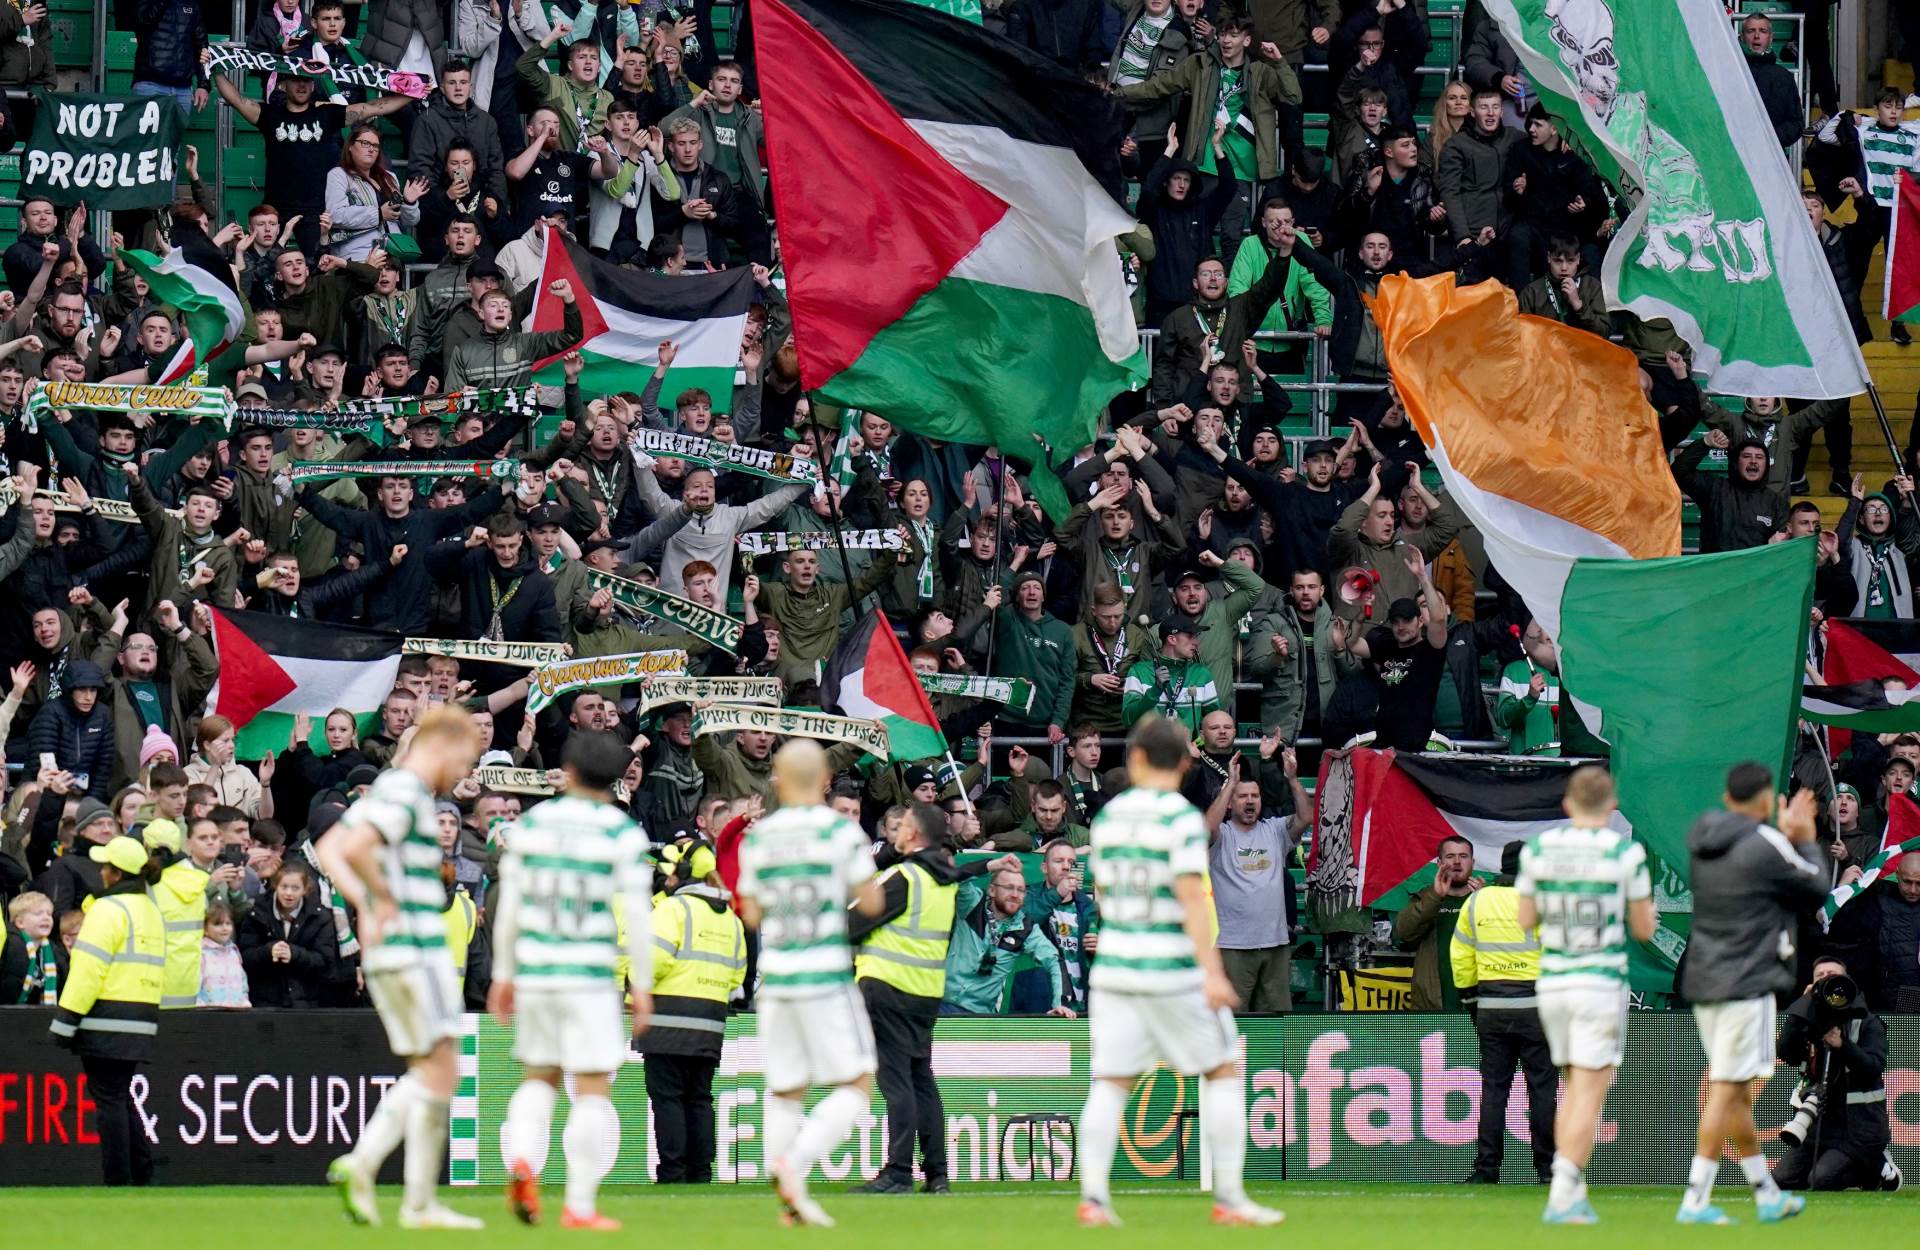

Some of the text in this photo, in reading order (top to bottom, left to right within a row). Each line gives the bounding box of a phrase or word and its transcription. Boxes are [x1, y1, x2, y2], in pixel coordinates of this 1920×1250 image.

[56, 101, 160, 137] NOT A
[45, 382, 202, 409] Ultras Celtic
[636, 428, 809, 479] NORTH CURVE
[662, 597, 741, 647] CURVE
[406, 639, 433, 651] OF
[462, 641, 500, 656] THE
[537, 656, 630, 697] Champions
[675, 682, 693, 695] OF
[712, 681, 740, 696] THE
[700, 709, 742, 726] PIRIT
[750, 711, 775, 726] OF
[802, 718, 837, 734] THE
[513, 771, 532, 786] OF
[1361, 985, 1413, 1010] THIS
[0, 1073, 100, 1145] FIRE
[178, 1073, 398, 1146] SECURIT
